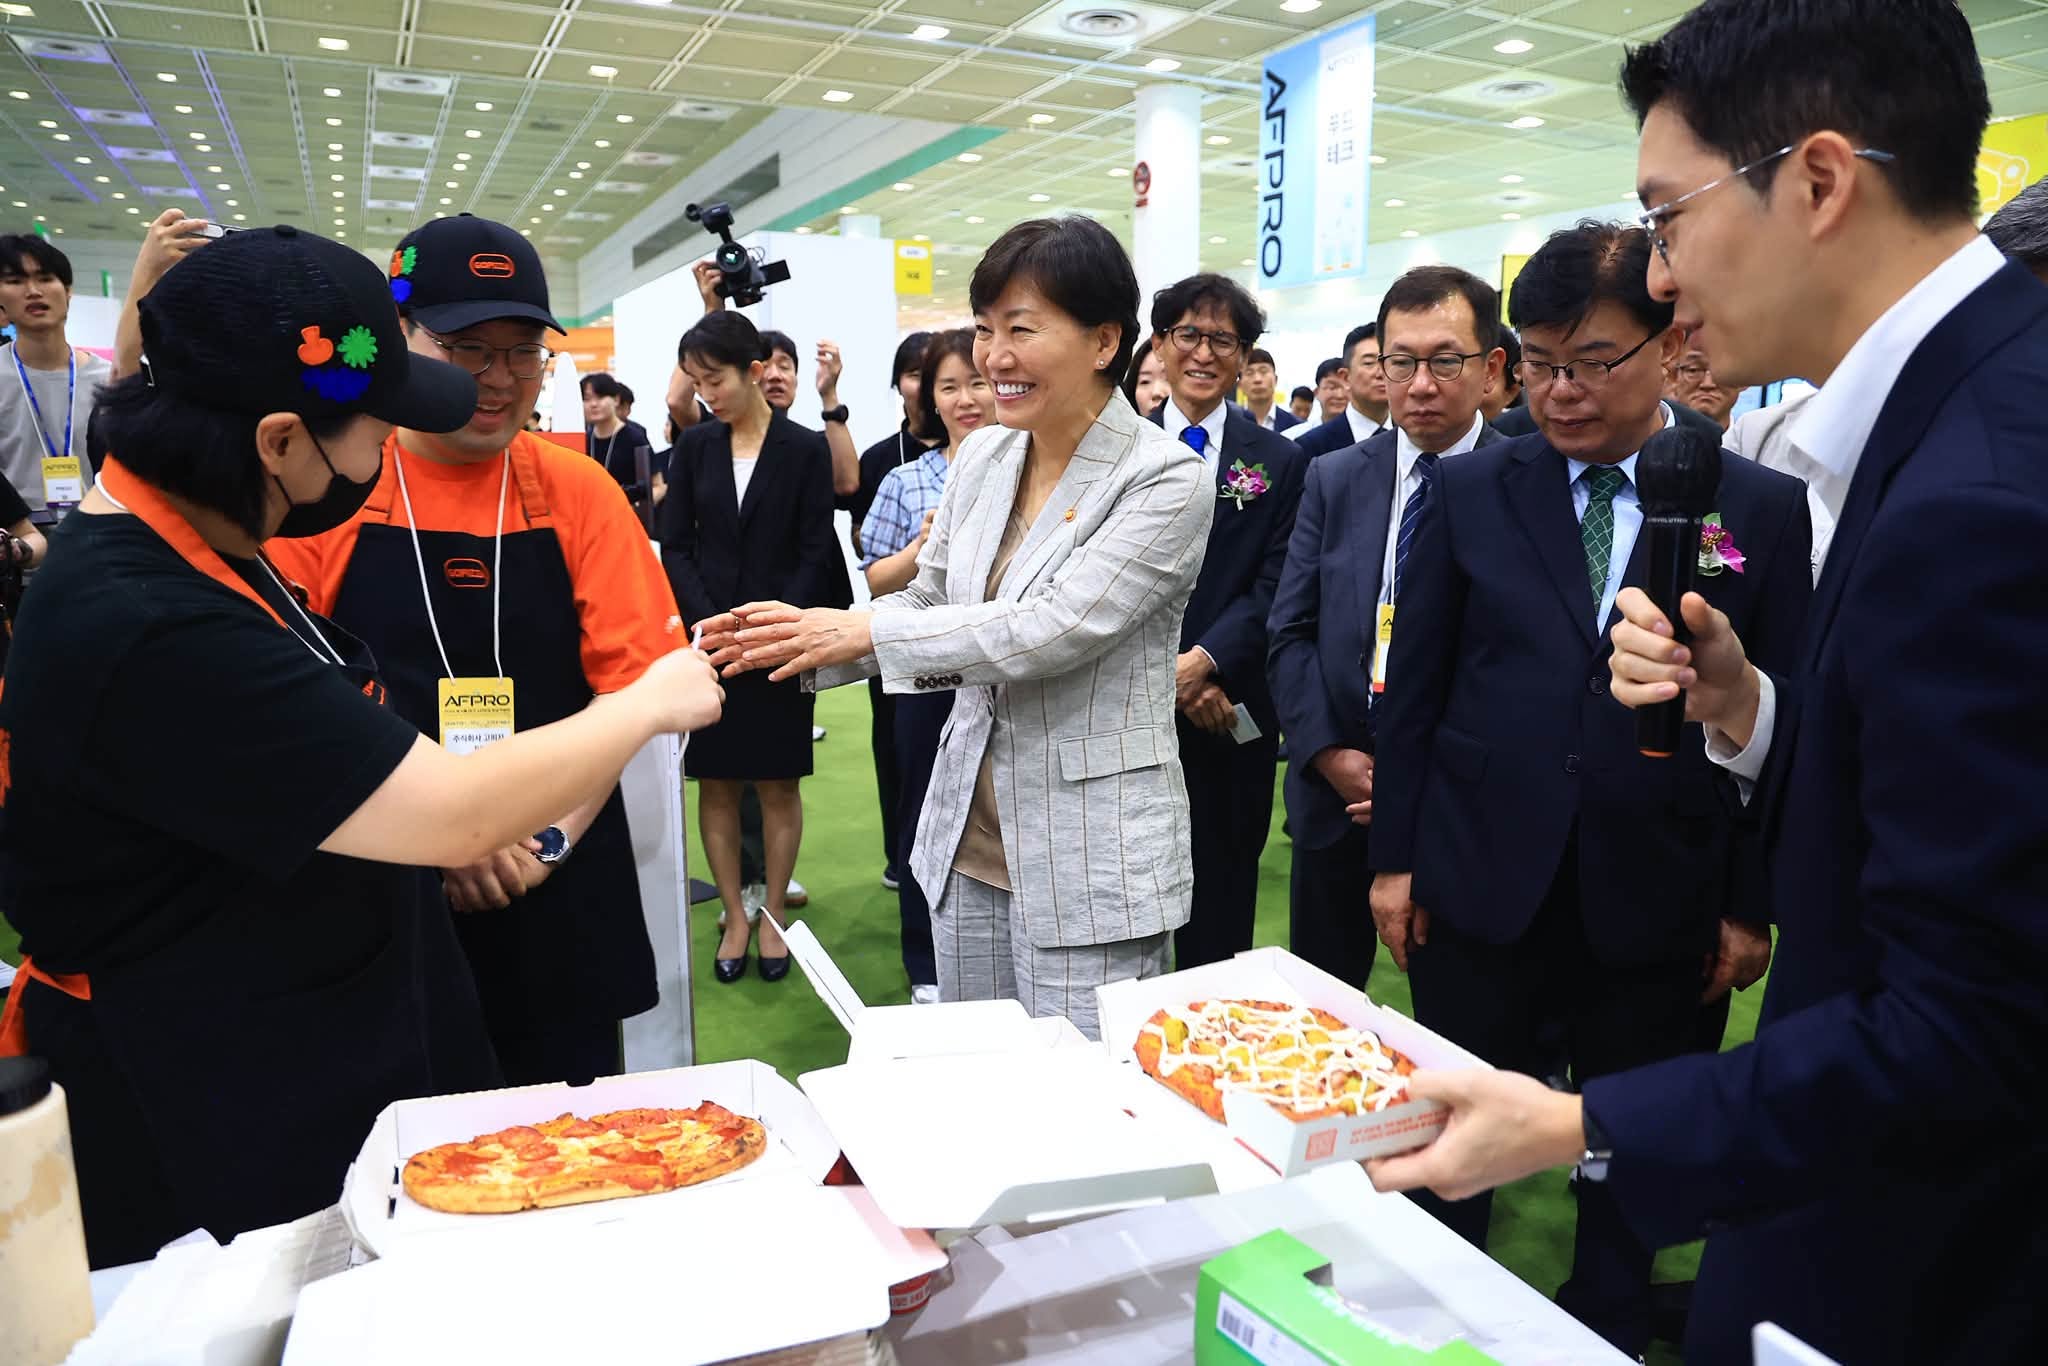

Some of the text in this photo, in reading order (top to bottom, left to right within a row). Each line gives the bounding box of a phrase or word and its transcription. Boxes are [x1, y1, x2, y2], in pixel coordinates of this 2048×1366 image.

[1327, 139, 1355, 165] 테크
[1261, 69, 1287, 278] AFPRO
[444, 695, 511, 707] AFPRO
